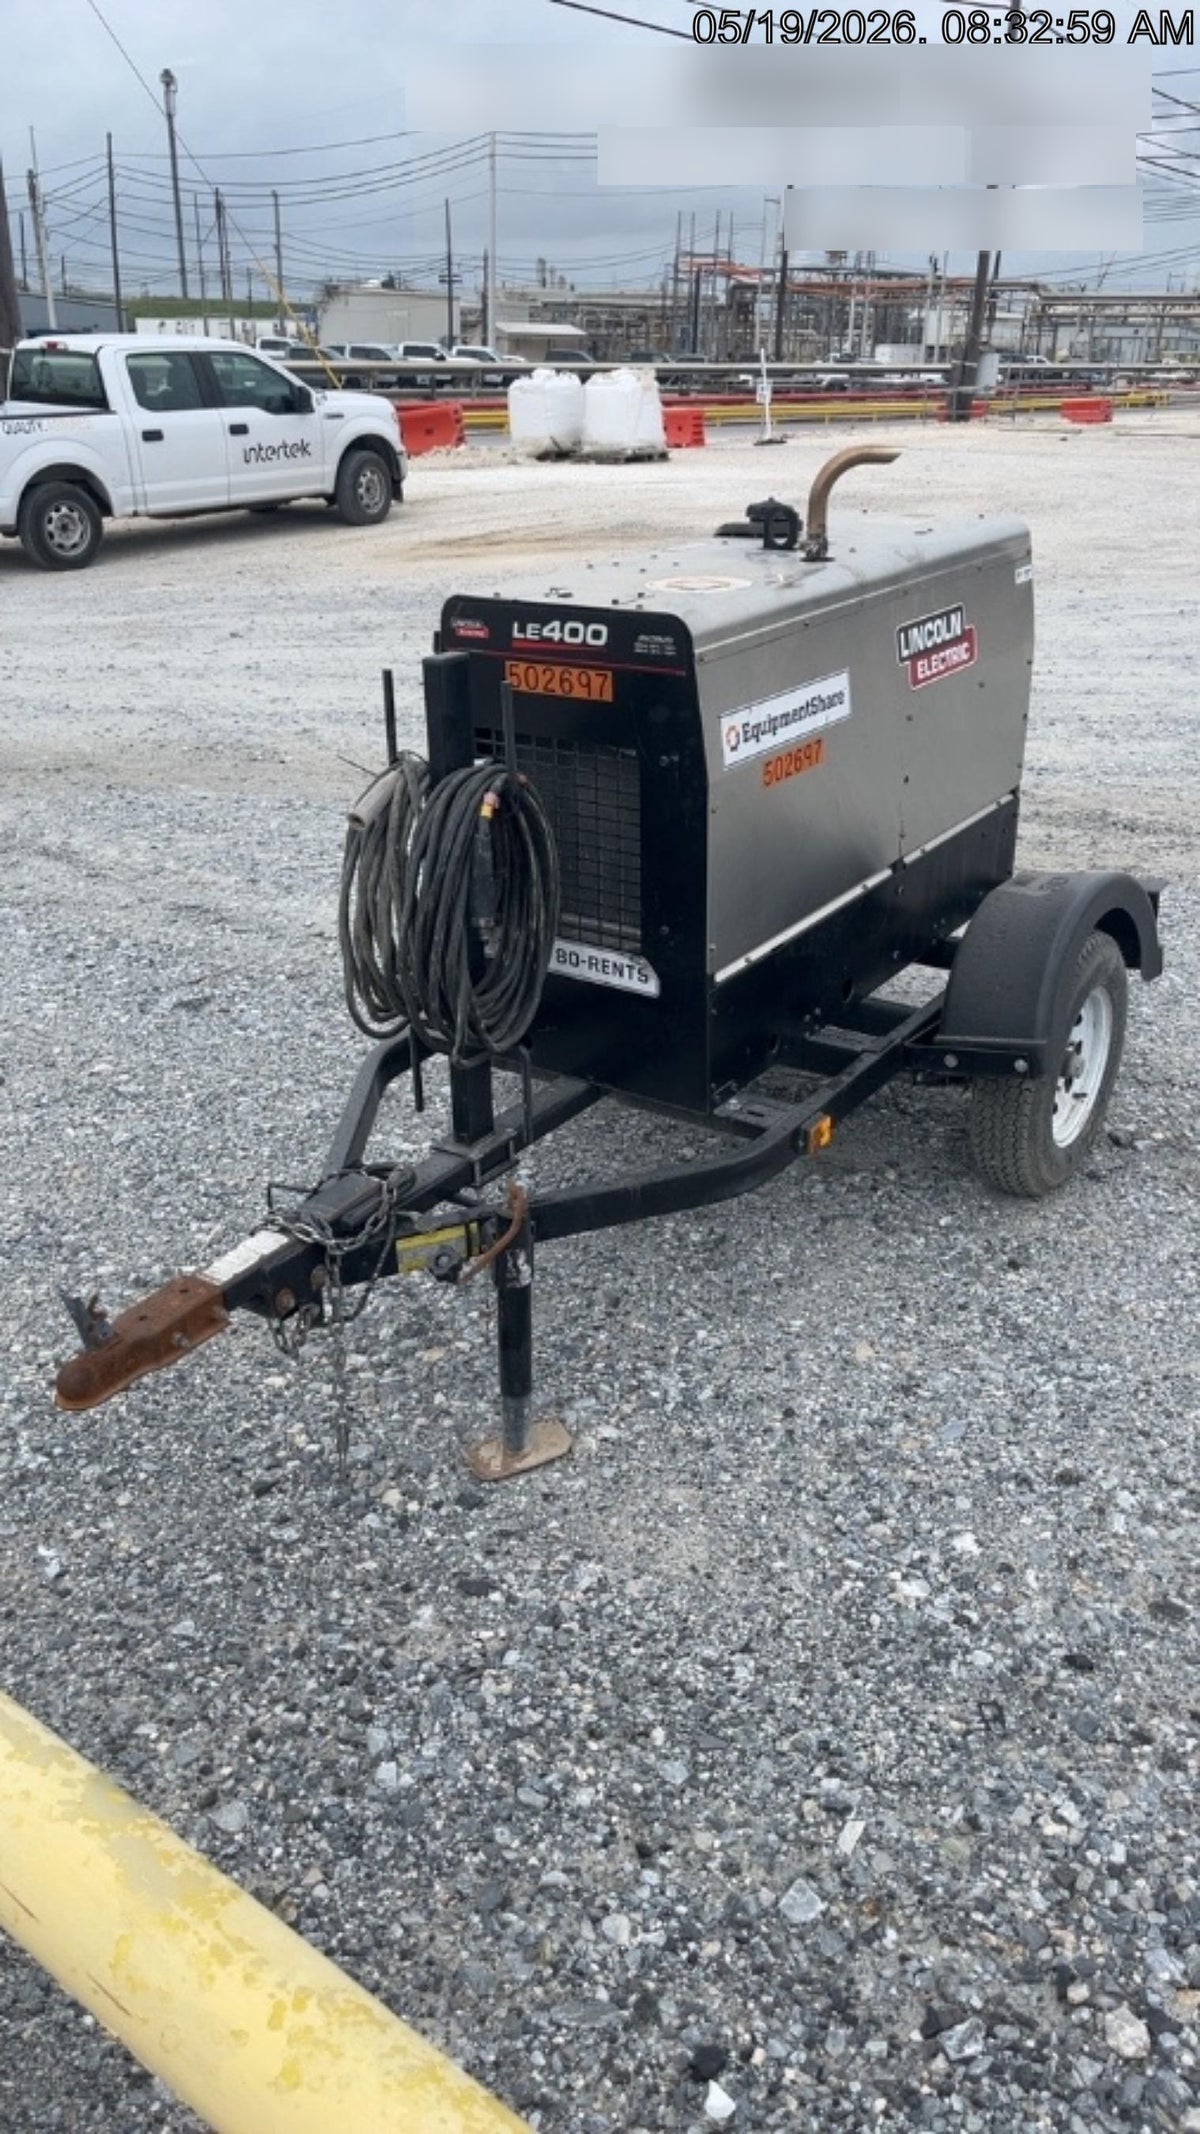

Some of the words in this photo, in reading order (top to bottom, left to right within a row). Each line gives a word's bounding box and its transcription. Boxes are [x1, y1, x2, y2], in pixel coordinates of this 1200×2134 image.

[243, 438, 312, 464] intertek
[512, 620, 608, 646] LE400
[900, 610, 962, 658] LINCOLN
[917, 642, 971, 680] ELECTRIC
[509, 663, 609, 698] 502697
[742, 690, 845, 743] EquipmentShare
[763, 738, 822, 787] 502697
